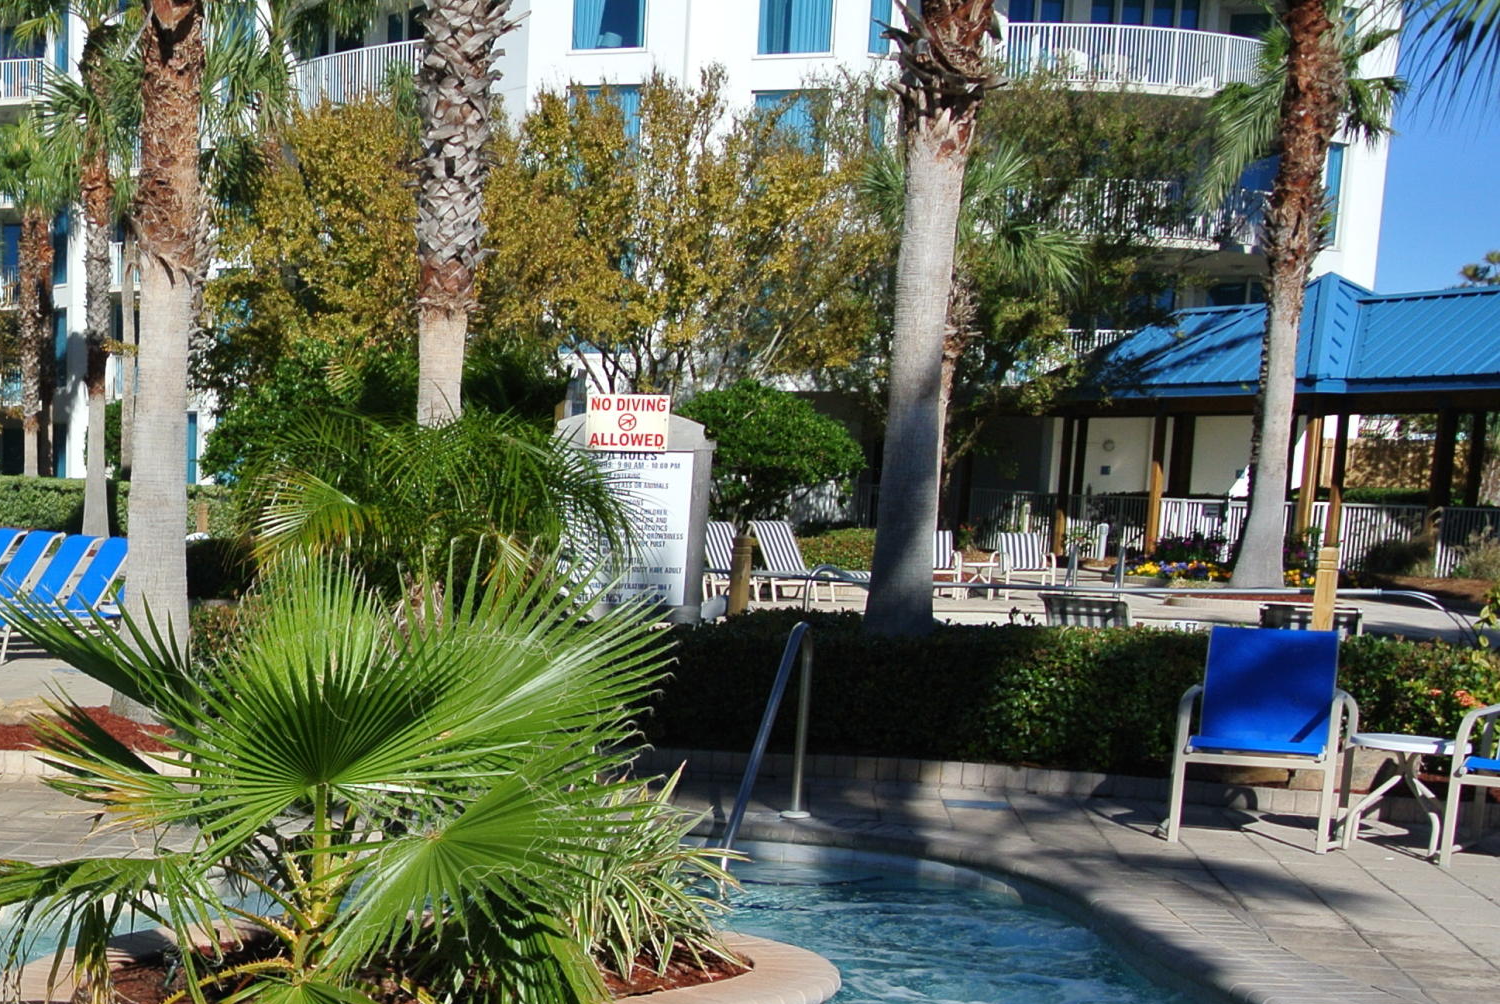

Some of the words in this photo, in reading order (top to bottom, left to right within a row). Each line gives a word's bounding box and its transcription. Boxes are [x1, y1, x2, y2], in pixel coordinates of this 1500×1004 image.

[590, 398, 611, 412] NO
[616, 398, 667, 412] DIVING
[589, 433, 665, 447] ALLOWED
[620, 453, 658, 461] RULES
